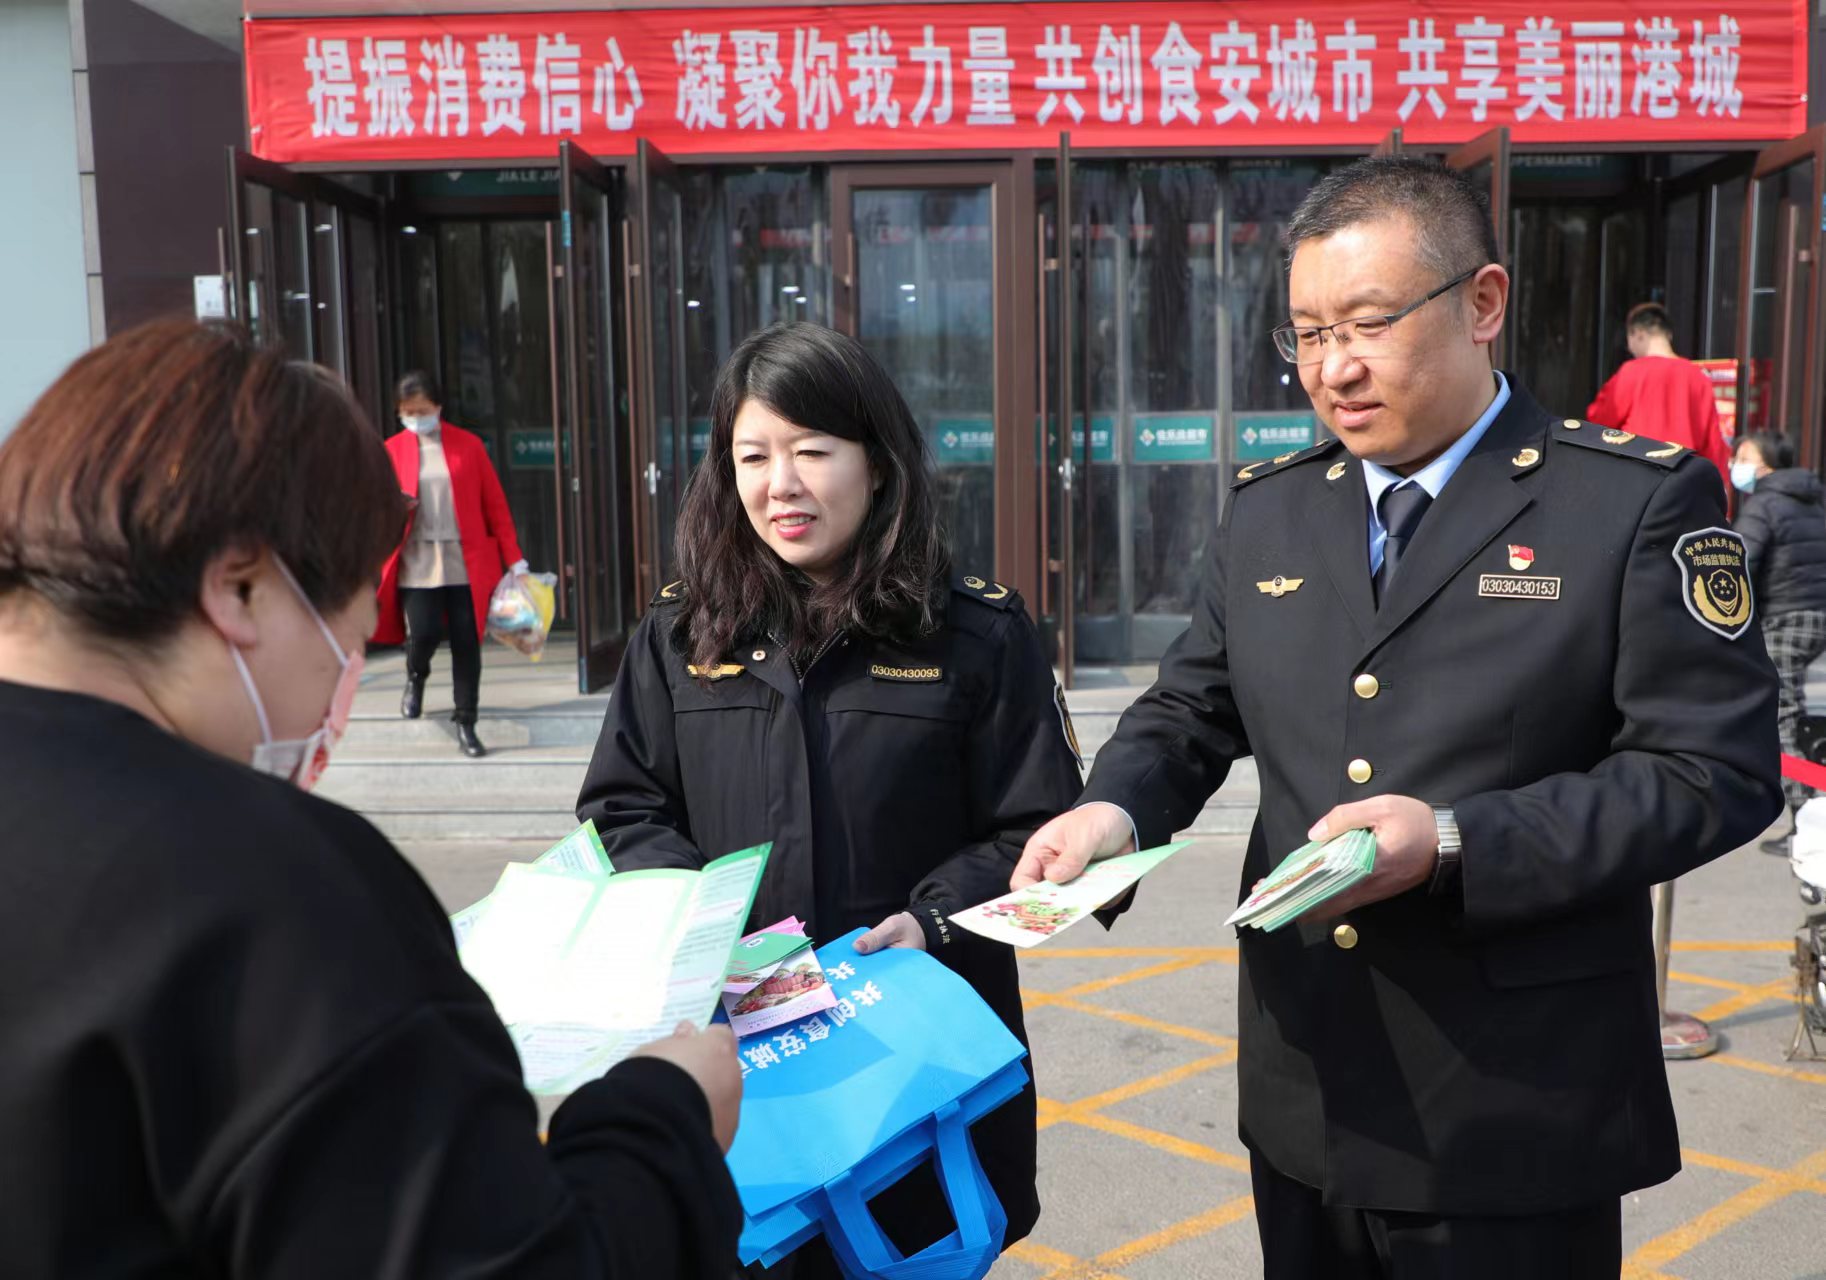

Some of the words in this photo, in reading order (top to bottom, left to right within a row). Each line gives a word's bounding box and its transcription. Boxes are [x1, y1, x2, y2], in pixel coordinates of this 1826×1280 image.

[303, 32, 644, 137] 提振消费信心
[674, 26, 1016, 130] 凝聚你我力量
[1034, 18, 1377, 125] 共创食安城市
[1397, 14, 1742, 121] 共享美丽港城
[1482, 578, 1555, 595] 03030430153
[871, 664, 940, 678] 03030430093
